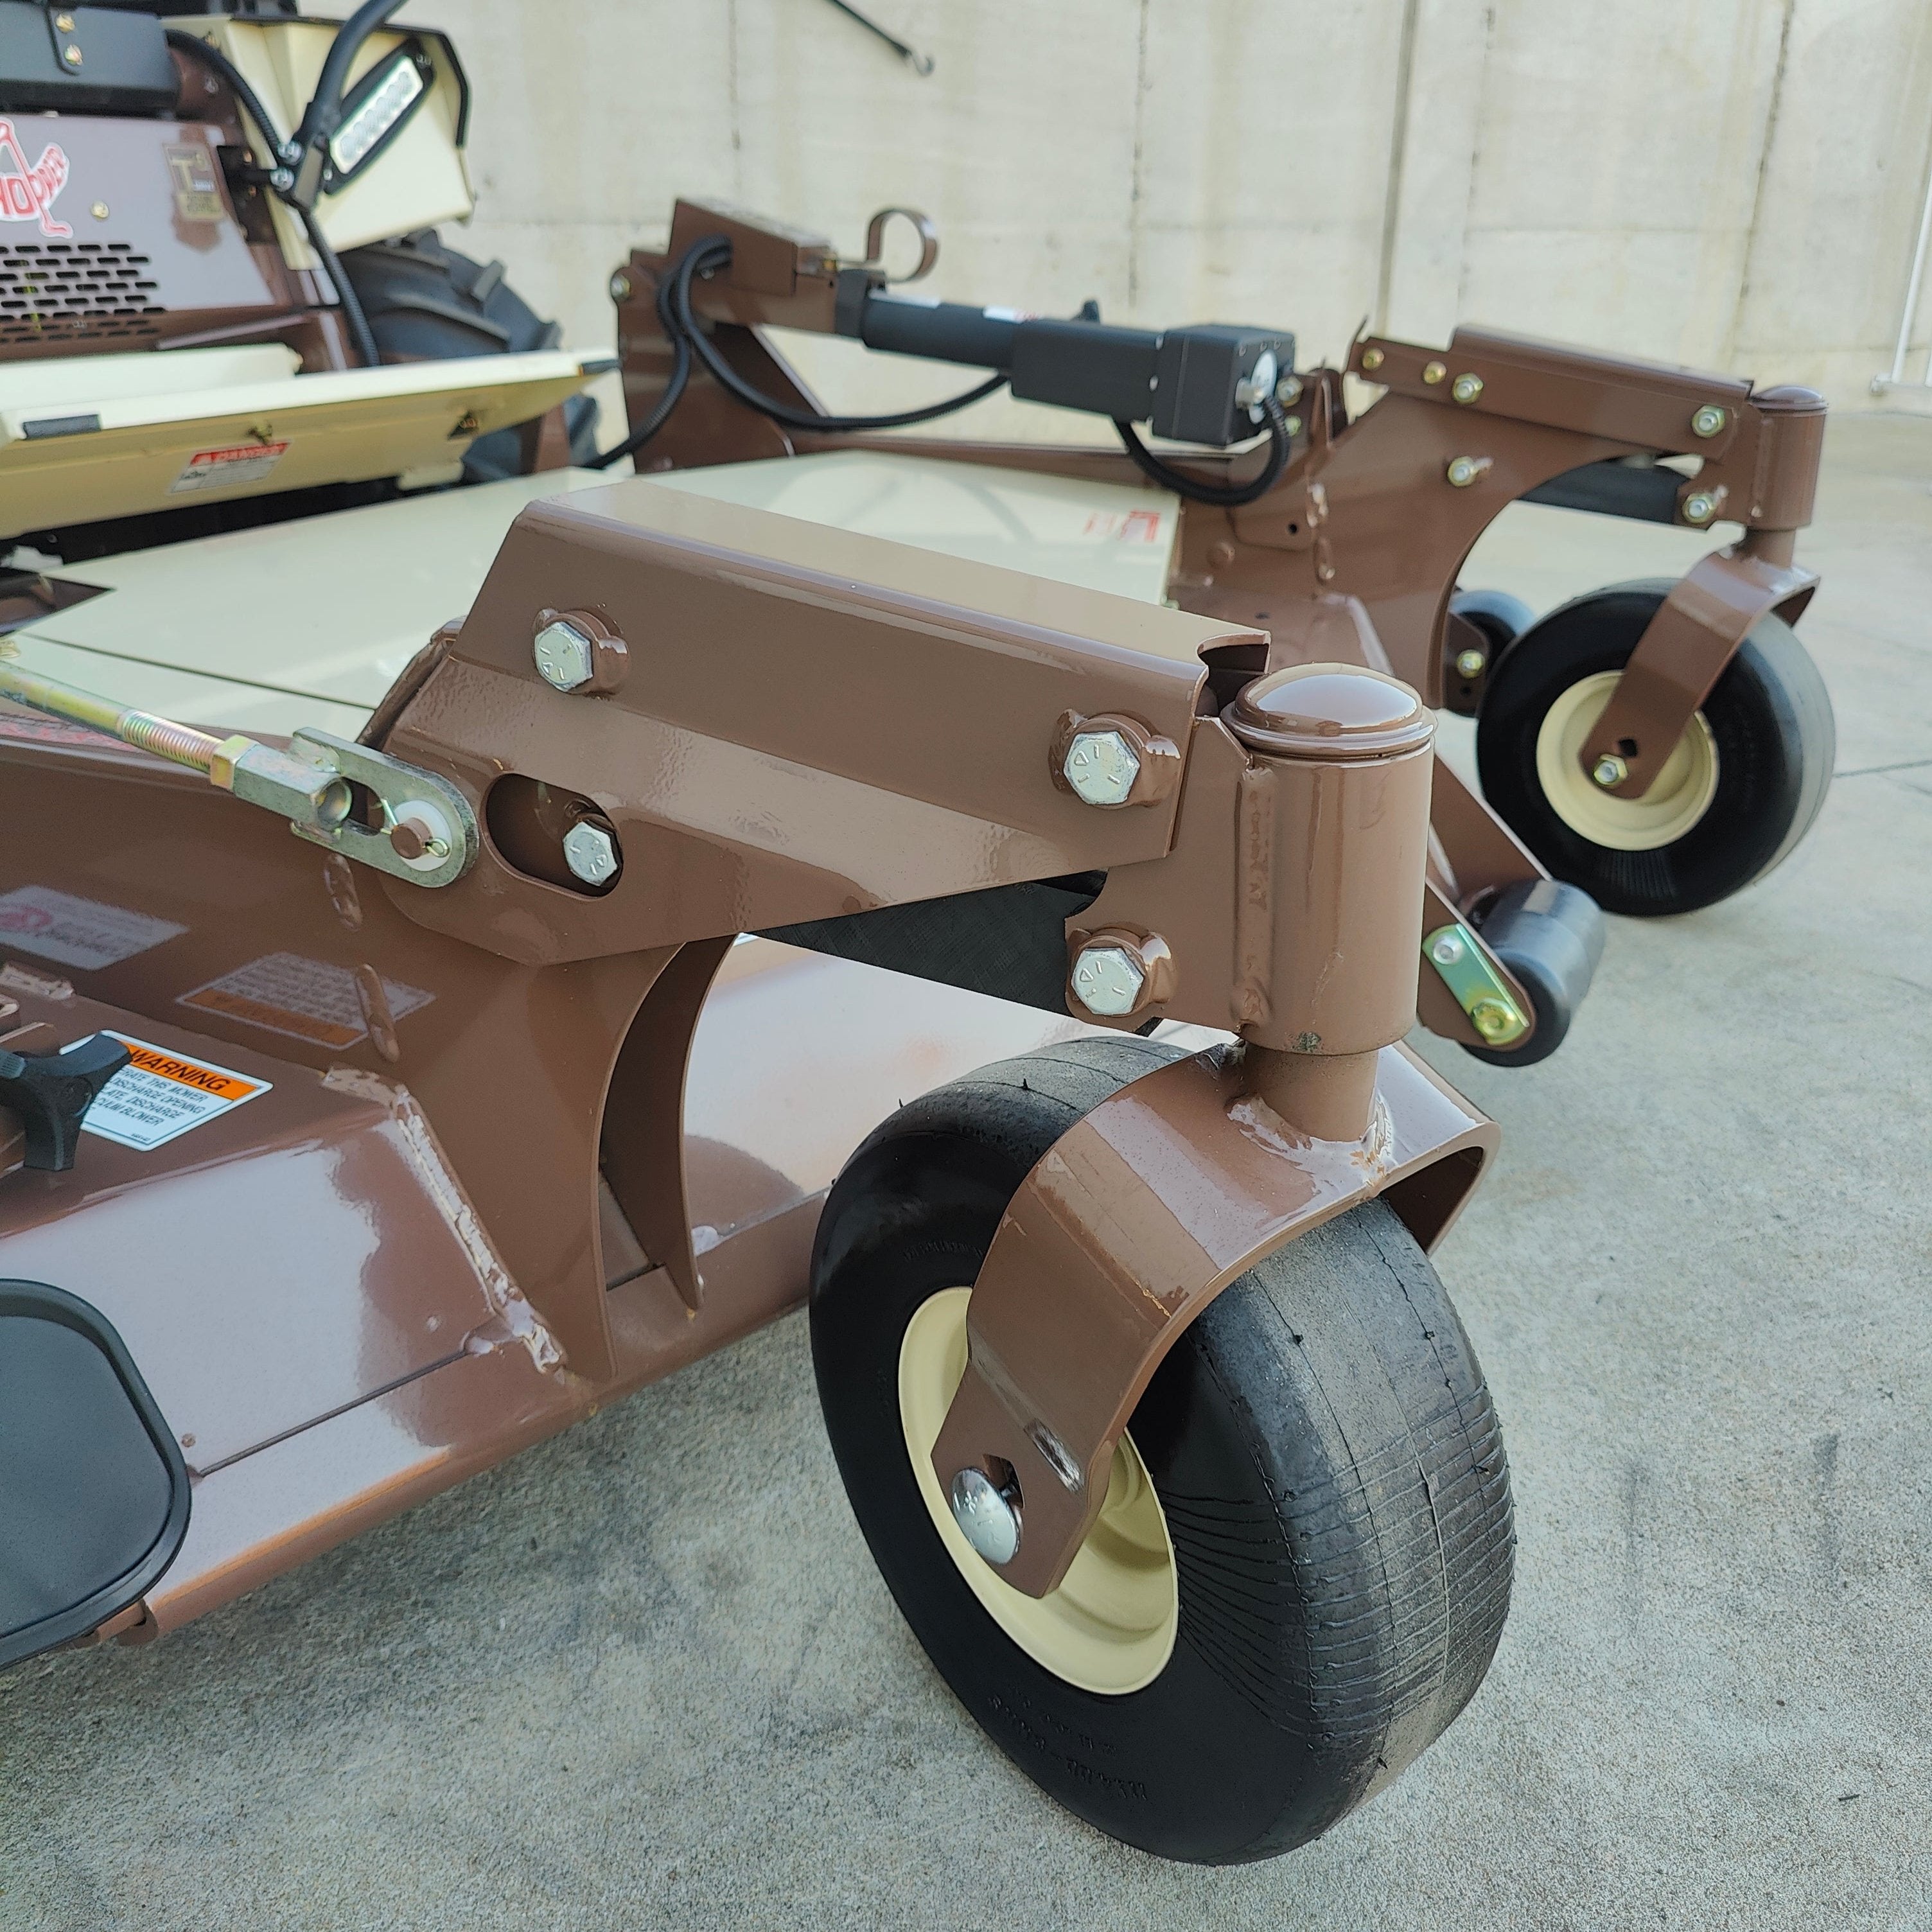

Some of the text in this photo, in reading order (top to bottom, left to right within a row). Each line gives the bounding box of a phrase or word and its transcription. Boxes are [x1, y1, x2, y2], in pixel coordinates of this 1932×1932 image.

[131, 1049, 231, 1091] WARNING
[146, 1077, 171, 1090] THIS
[168, 1085, 209, 1103] MOWER
[119, 1105, 165, 1127] BLOWER
[125, 1096, 185, 1119] DISCHARGE
[161, 1095, 206, 1114] OPENING
